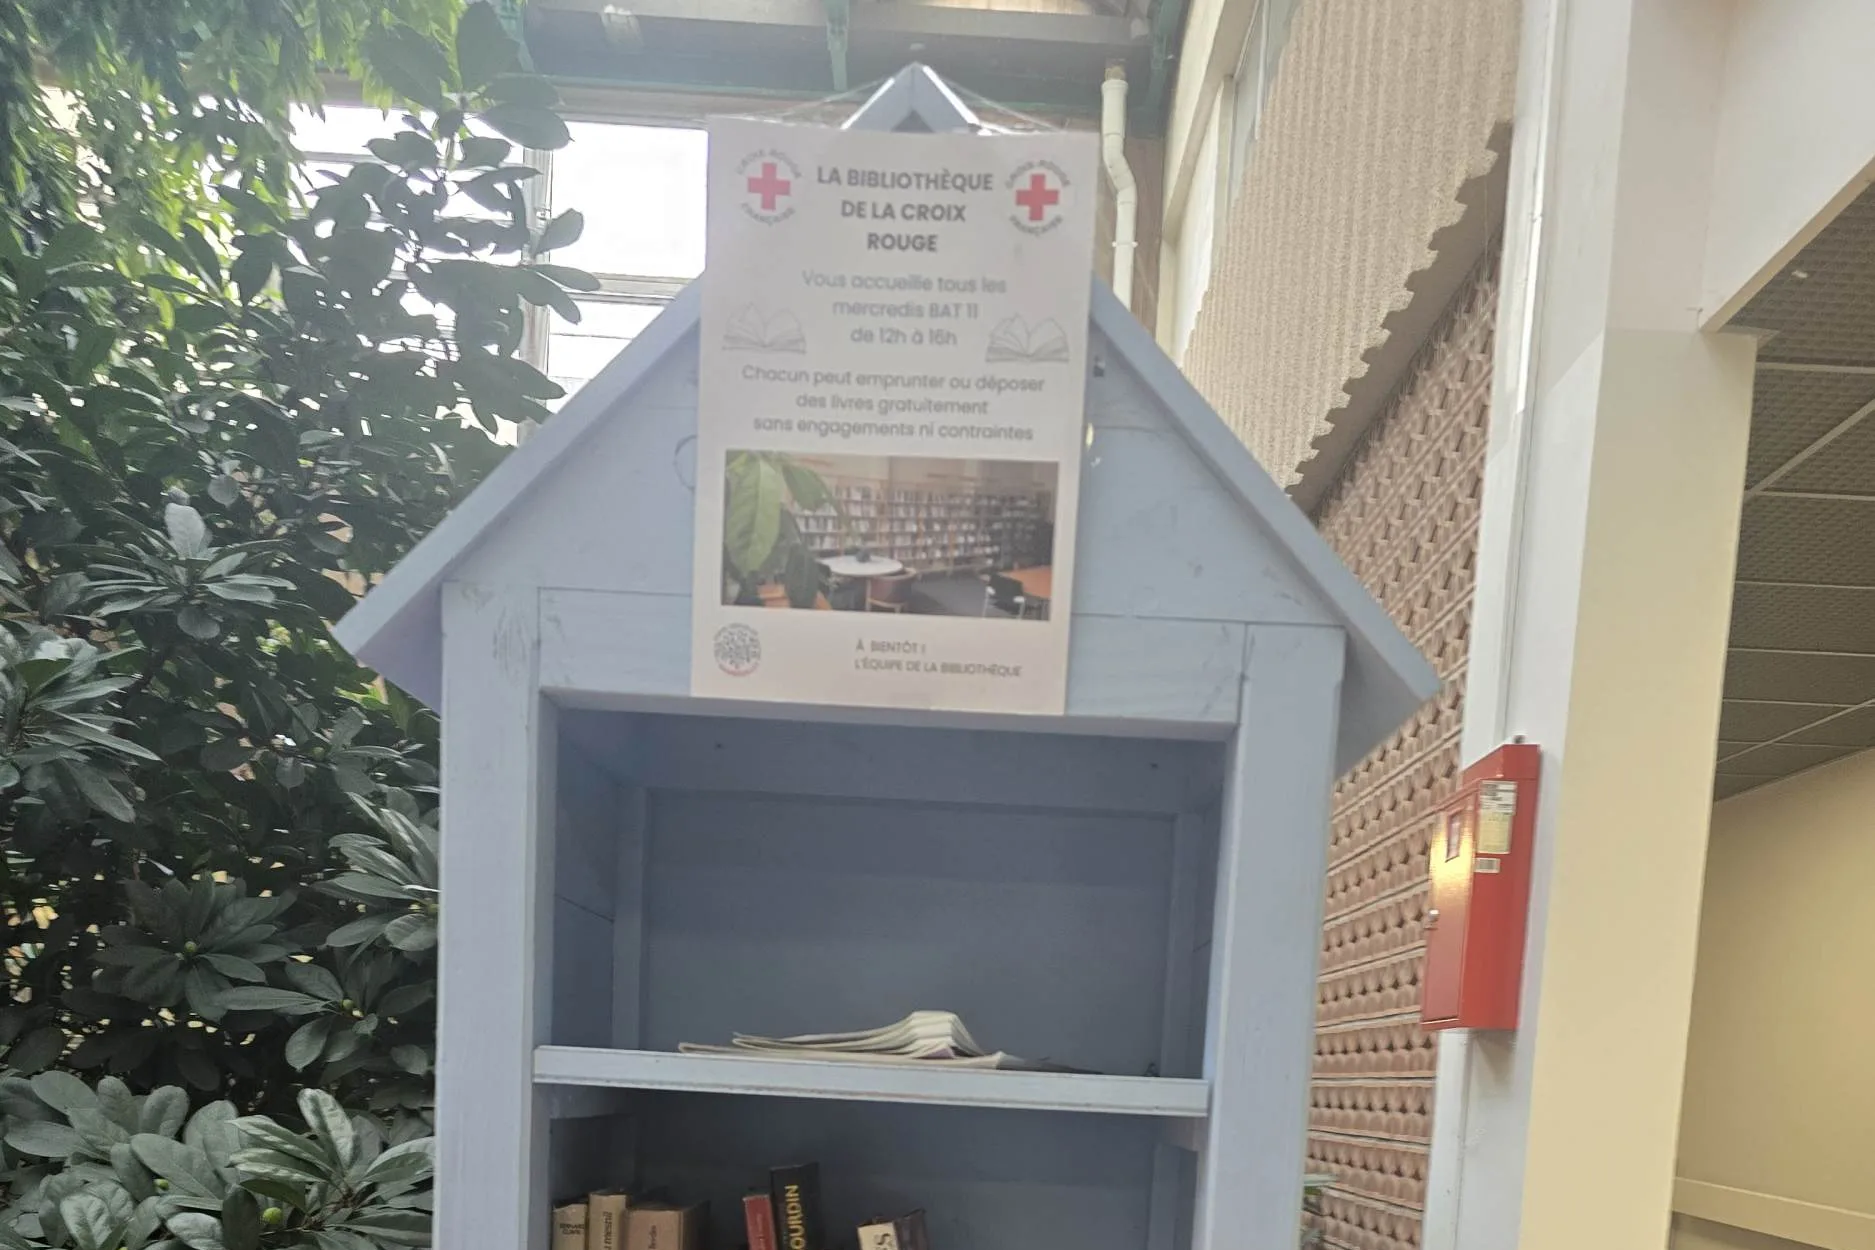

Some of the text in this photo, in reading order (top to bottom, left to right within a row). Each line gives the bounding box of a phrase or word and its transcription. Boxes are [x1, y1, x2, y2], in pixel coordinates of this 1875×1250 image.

[817, 166, 993, 192] LA BIBLIOTHÈQUE
[841, 200, 966, 222] DE LA CROIX
[867, 233, 938, 252] ROUGE
[802, 269, 846, 288] Vous
[937, 276, 977, 293] tous
[981, 276, 1007, 294] les
[832, 301, 924, 319] mercredis
[851, 326, 873, 344] de
[911, 329, 923, 345] à
[741, 364, 1045, 396] Chacun peut emprunter ou déposer
[796, 393, 989, 415] des livres gratuitement
[753, 415, 1034, 441] sans engagements ni contraintes
